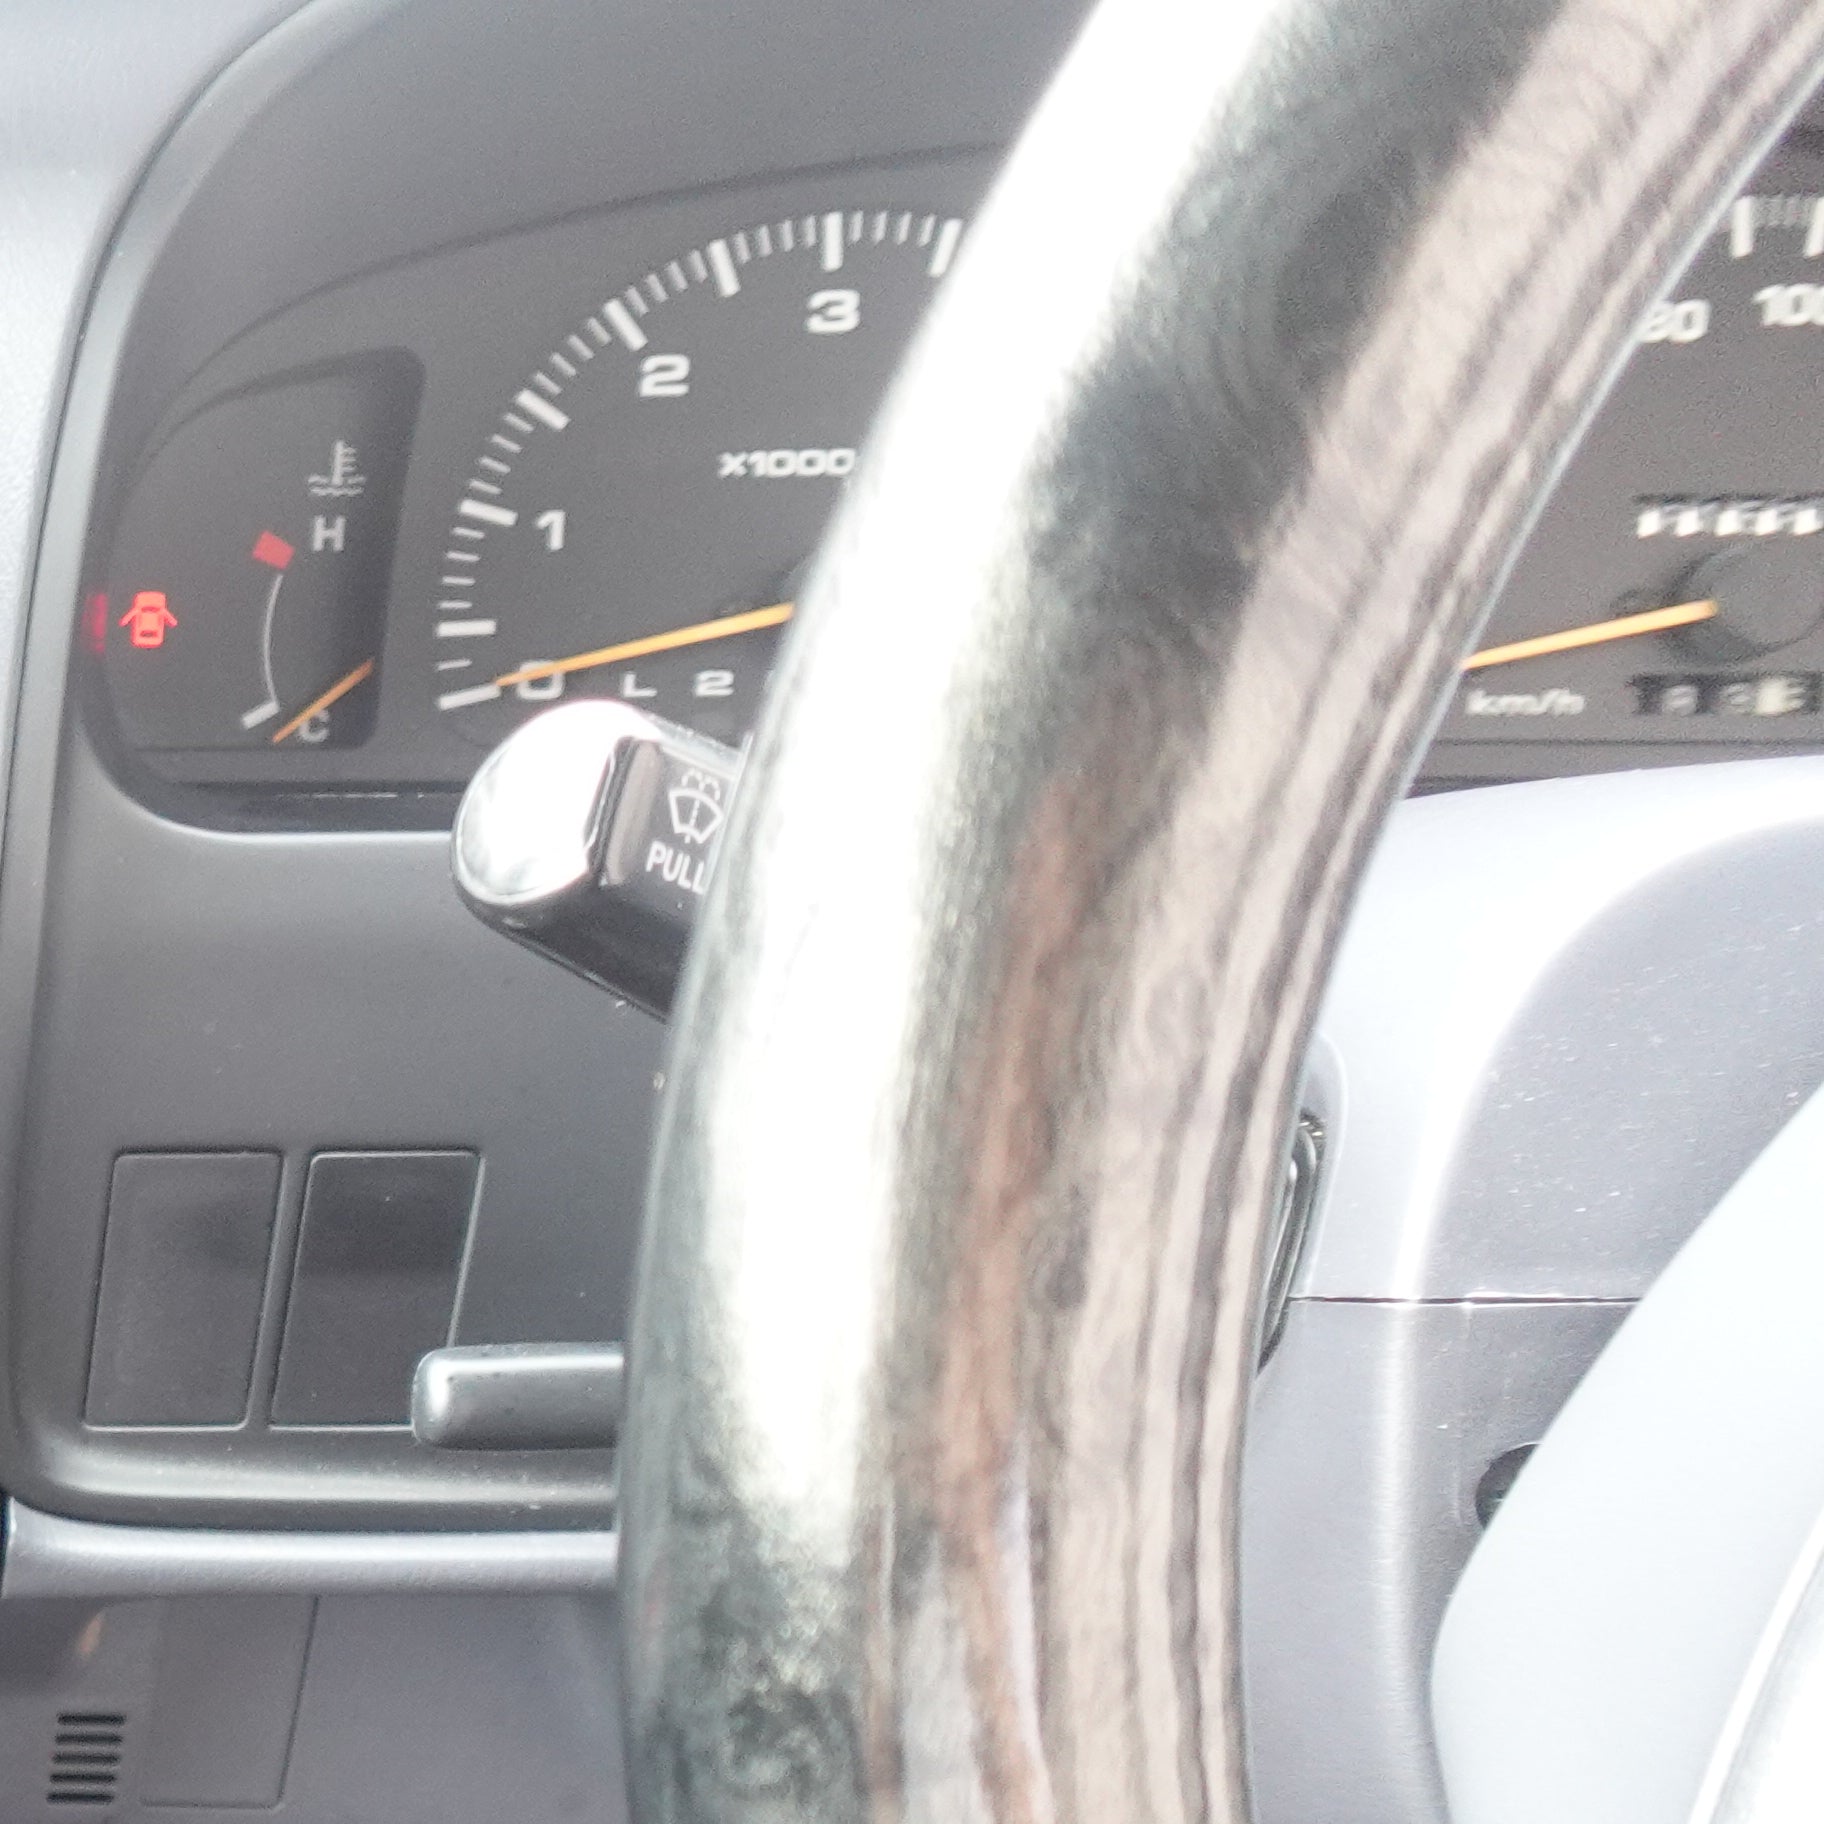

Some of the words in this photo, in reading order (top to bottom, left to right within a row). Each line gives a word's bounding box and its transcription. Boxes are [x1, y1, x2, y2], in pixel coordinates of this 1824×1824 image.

[805, 288, 862, 334] 3
[638, 353, 692, 399] 2
[312, 513, 348, 552] H
[534, 509, 567, 552] 1
[515, 659, 566, 701] 0
[621, 670, 658, 698] L
[694, 669, 735, 697] 2
[299, 706, 331, 744] C
[645, 840, 706, 896] PULL
